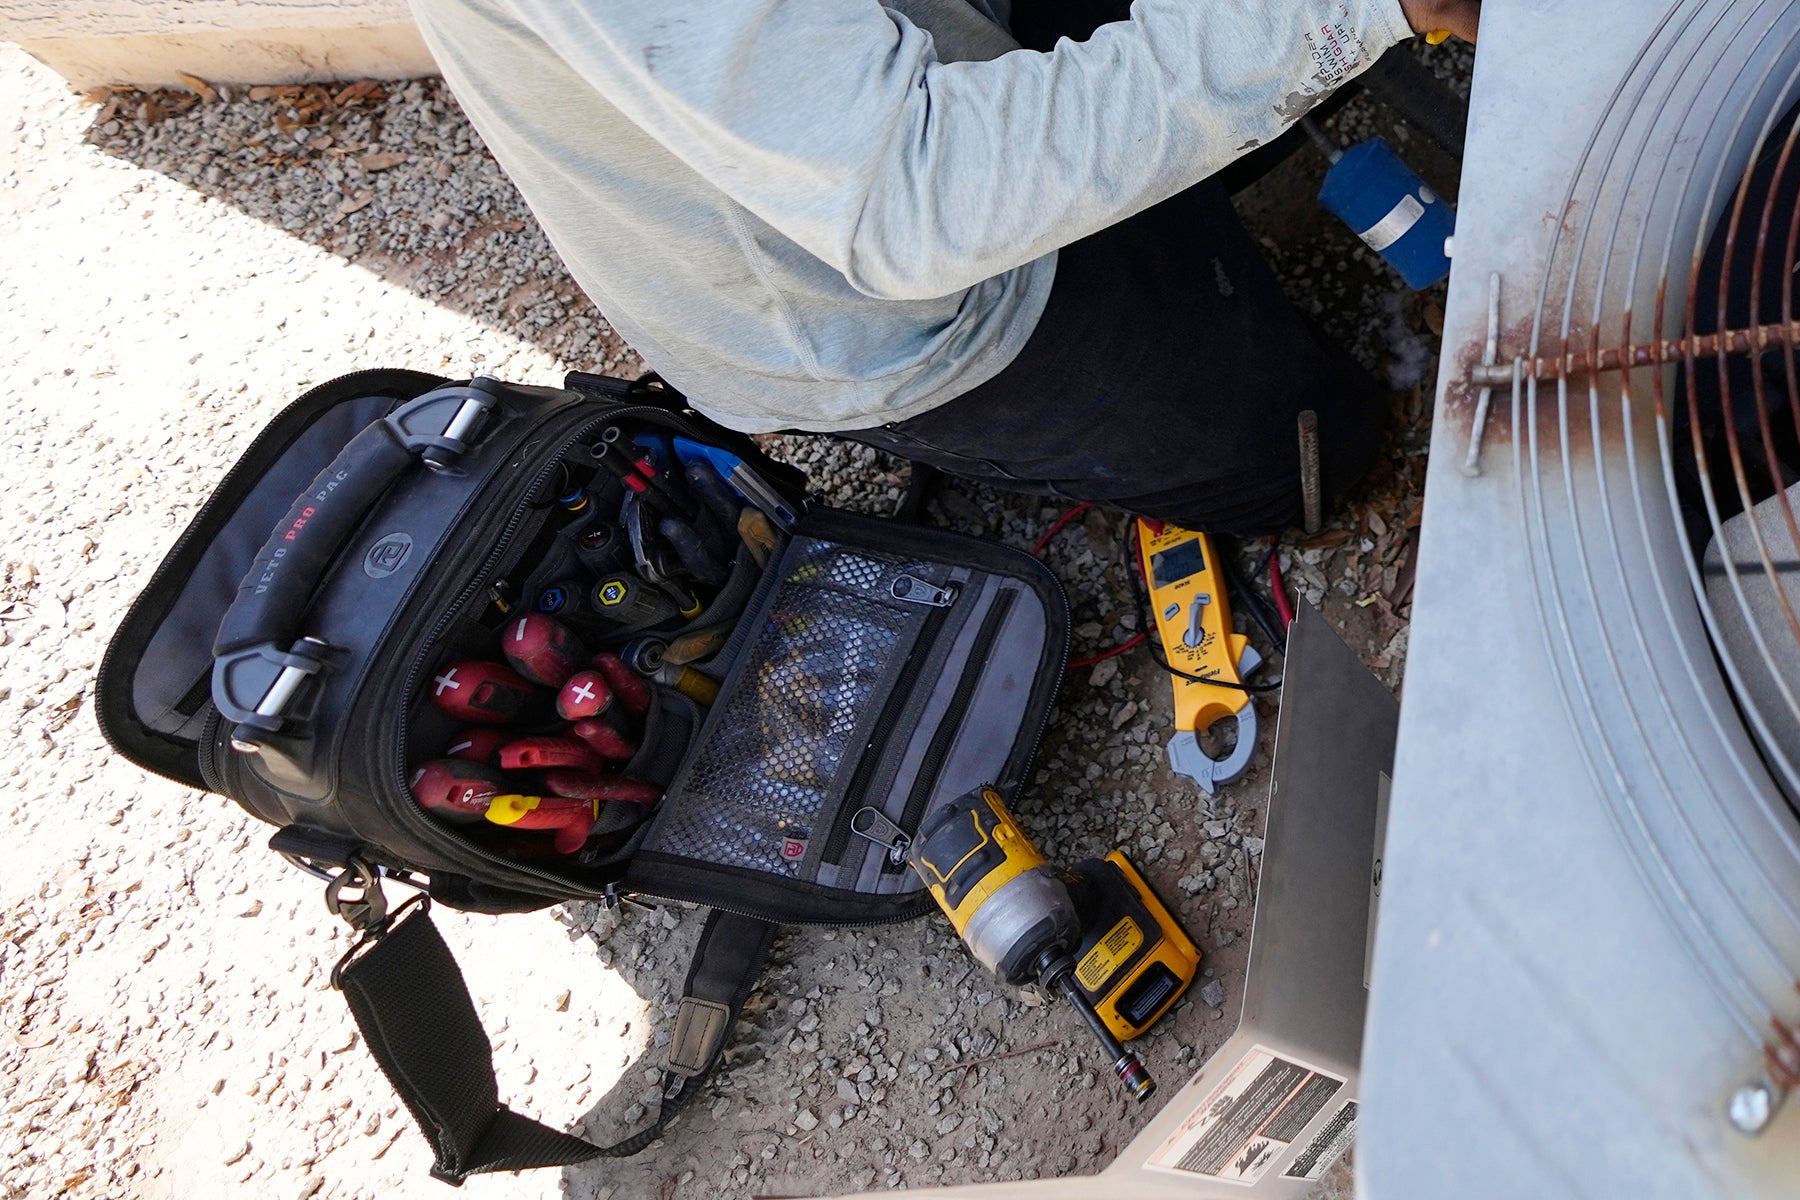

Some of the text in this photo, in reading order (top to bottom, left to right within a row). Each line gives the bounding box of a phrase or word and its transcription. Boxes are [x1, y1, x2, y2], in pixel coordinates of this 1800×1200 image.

[1304, 33, 1334, 81] SPYDER
[1319, 22, 1343, 57] GUAR
[1320, 45, 1343, 75] SWIM
[255, 463, 352, 594] VETO PRO PAC
